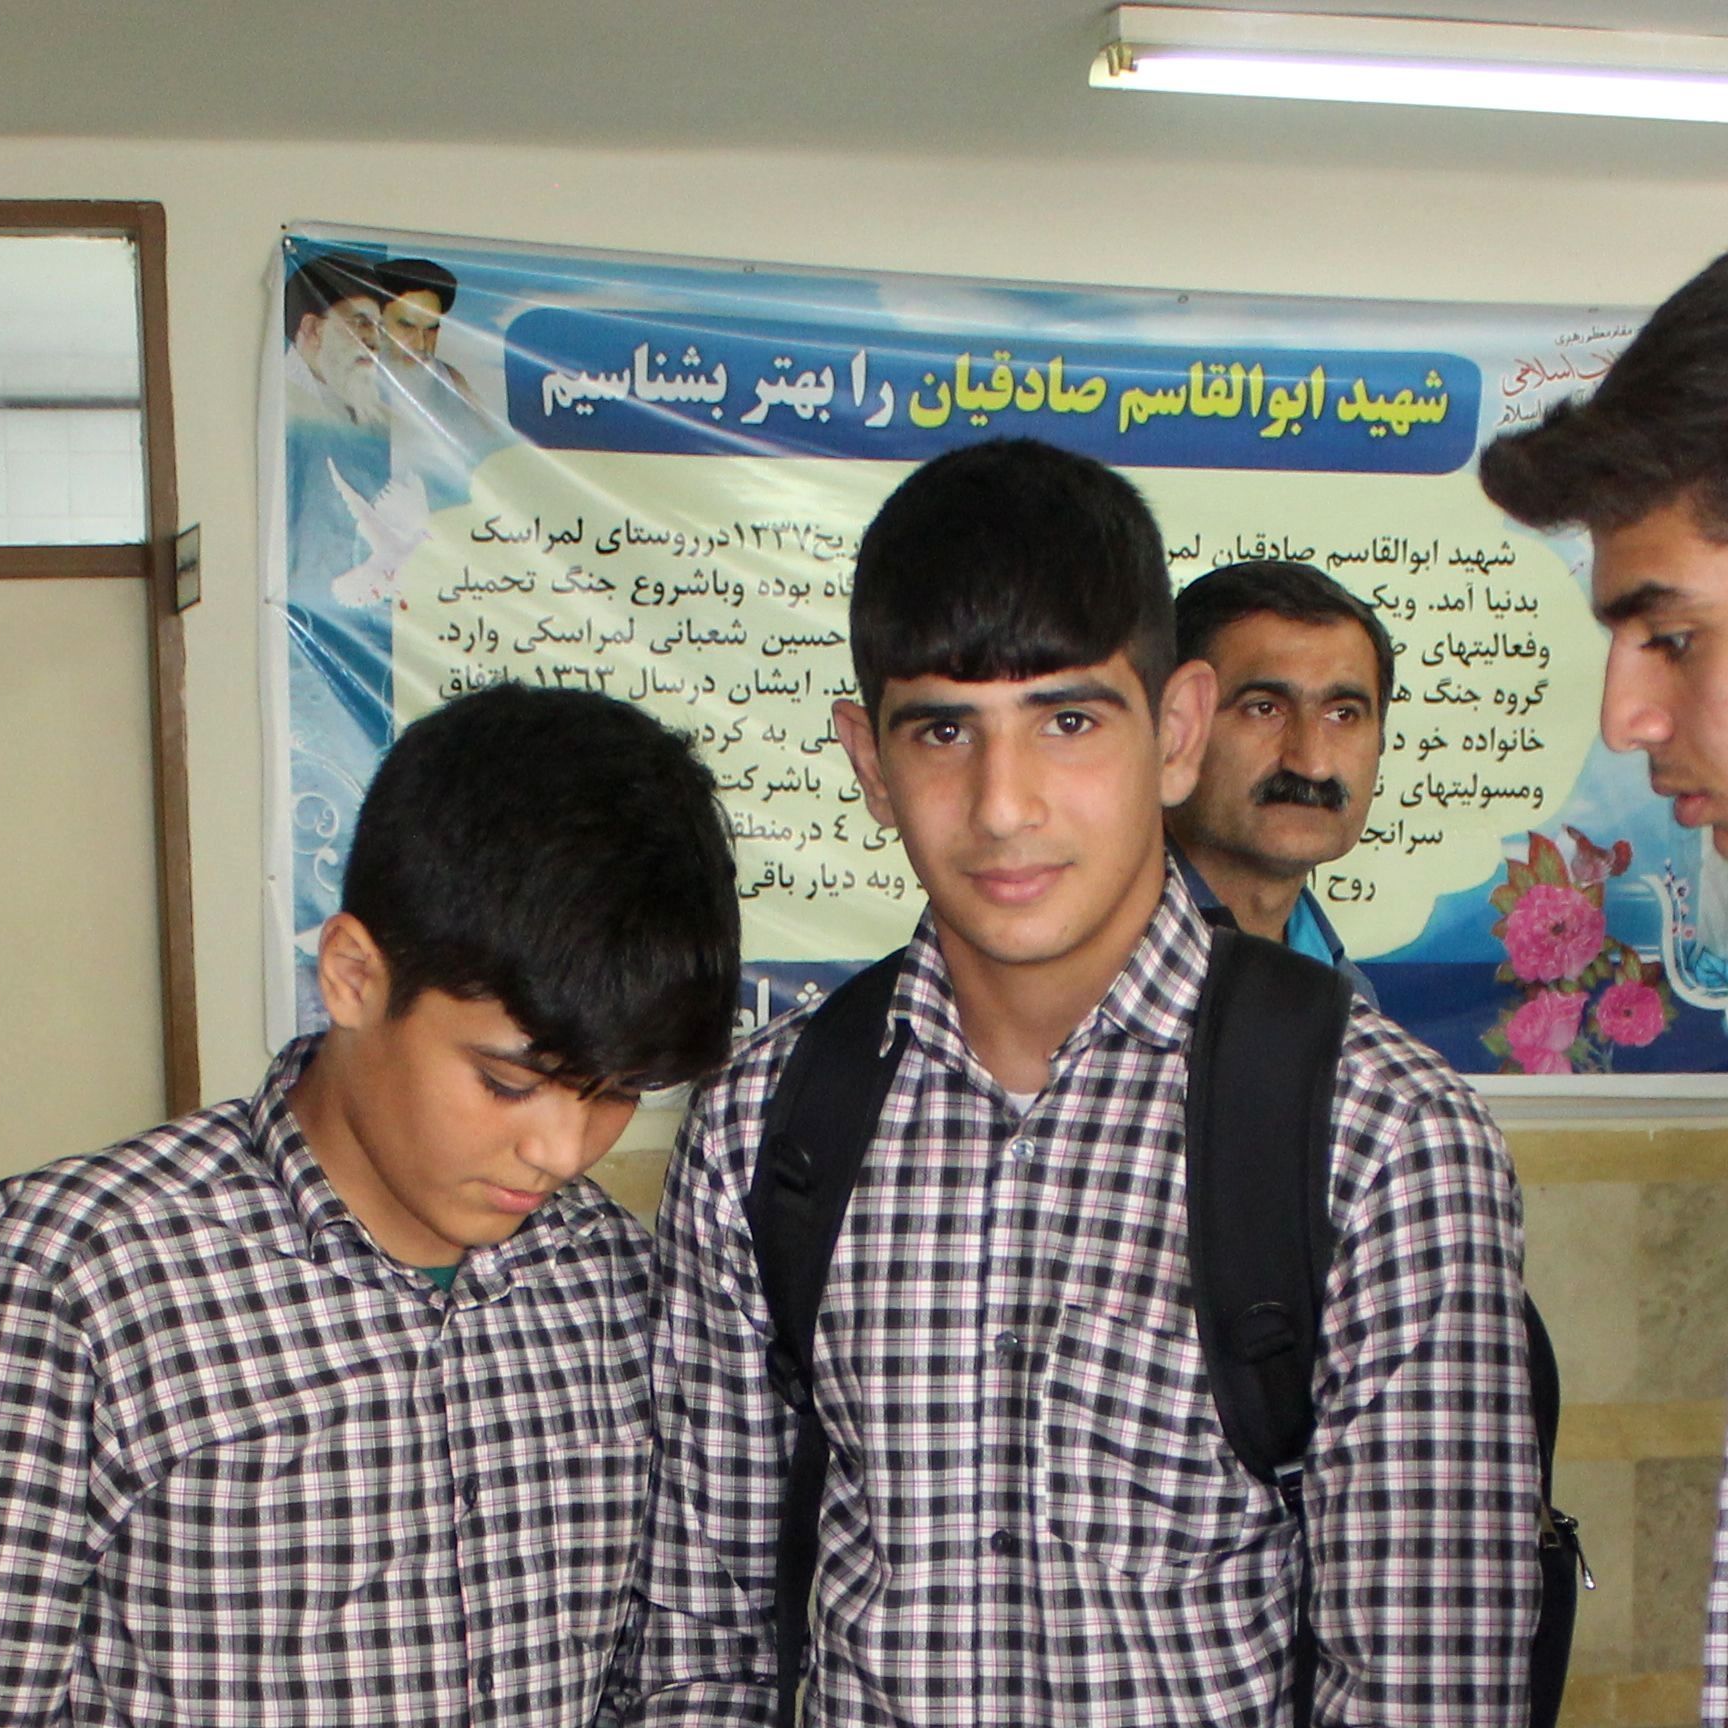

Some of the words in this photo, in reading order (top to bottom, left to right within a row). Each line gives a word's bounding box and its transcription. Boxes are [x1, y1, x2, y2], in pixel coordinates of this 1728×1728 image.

[541, 341, 728, 420] بشناسیم
[739, 355, 835, 425] بهتر
[850, 346, 895, 428] را
[908, 350, 1107, 428] صادقیان
[1118, 361, 1326, 438] ابوالقاسم
[1337, 368, 1449, 437] شهید
[470, 515, 584, 554] لمراسک
[1167, 533, 1201, 566] لمر
[1211, 533, 1316, 569] صادقیان
[1326, 536, 1439, 575] ابوالقاسم
[1448, 540, 1516, 576] شهید
[436, 565, 537, 605] تحمیلی
[551, 564, 617, 601] جنگ
[630, 567, 745, 606] وباشروع
[757, 576, 811, 608] بوده
[1427, 581, 1475, 613] آمد.
[1485, 585, 1539, 619] بدنیا
[512, 615, 636, 655] لمراسکی
[648, 617, 748, 655] شعبانی
[760, 628, 847, 657] حسین
[1421, 631, 1551, 669] وفعالیتهای
[727, 668, 812, 704] ایشان
[1422, 676, 1483, 713] جنگ
[1493, 679, 1550, 716] گروه
[761, 723, 787, 750] به
[1461, 725, 1545, 762] خانواده
[1399, 772, 1544, 809] ومسولیتهای
[1359, 818, 1444, 855] سرانج
[737, 860, 795, 900] باقی
[804, 862, 856, 900] دیار
[866, 871, 906, 900] وبه
[1327, 874, 1377, 902] روح
